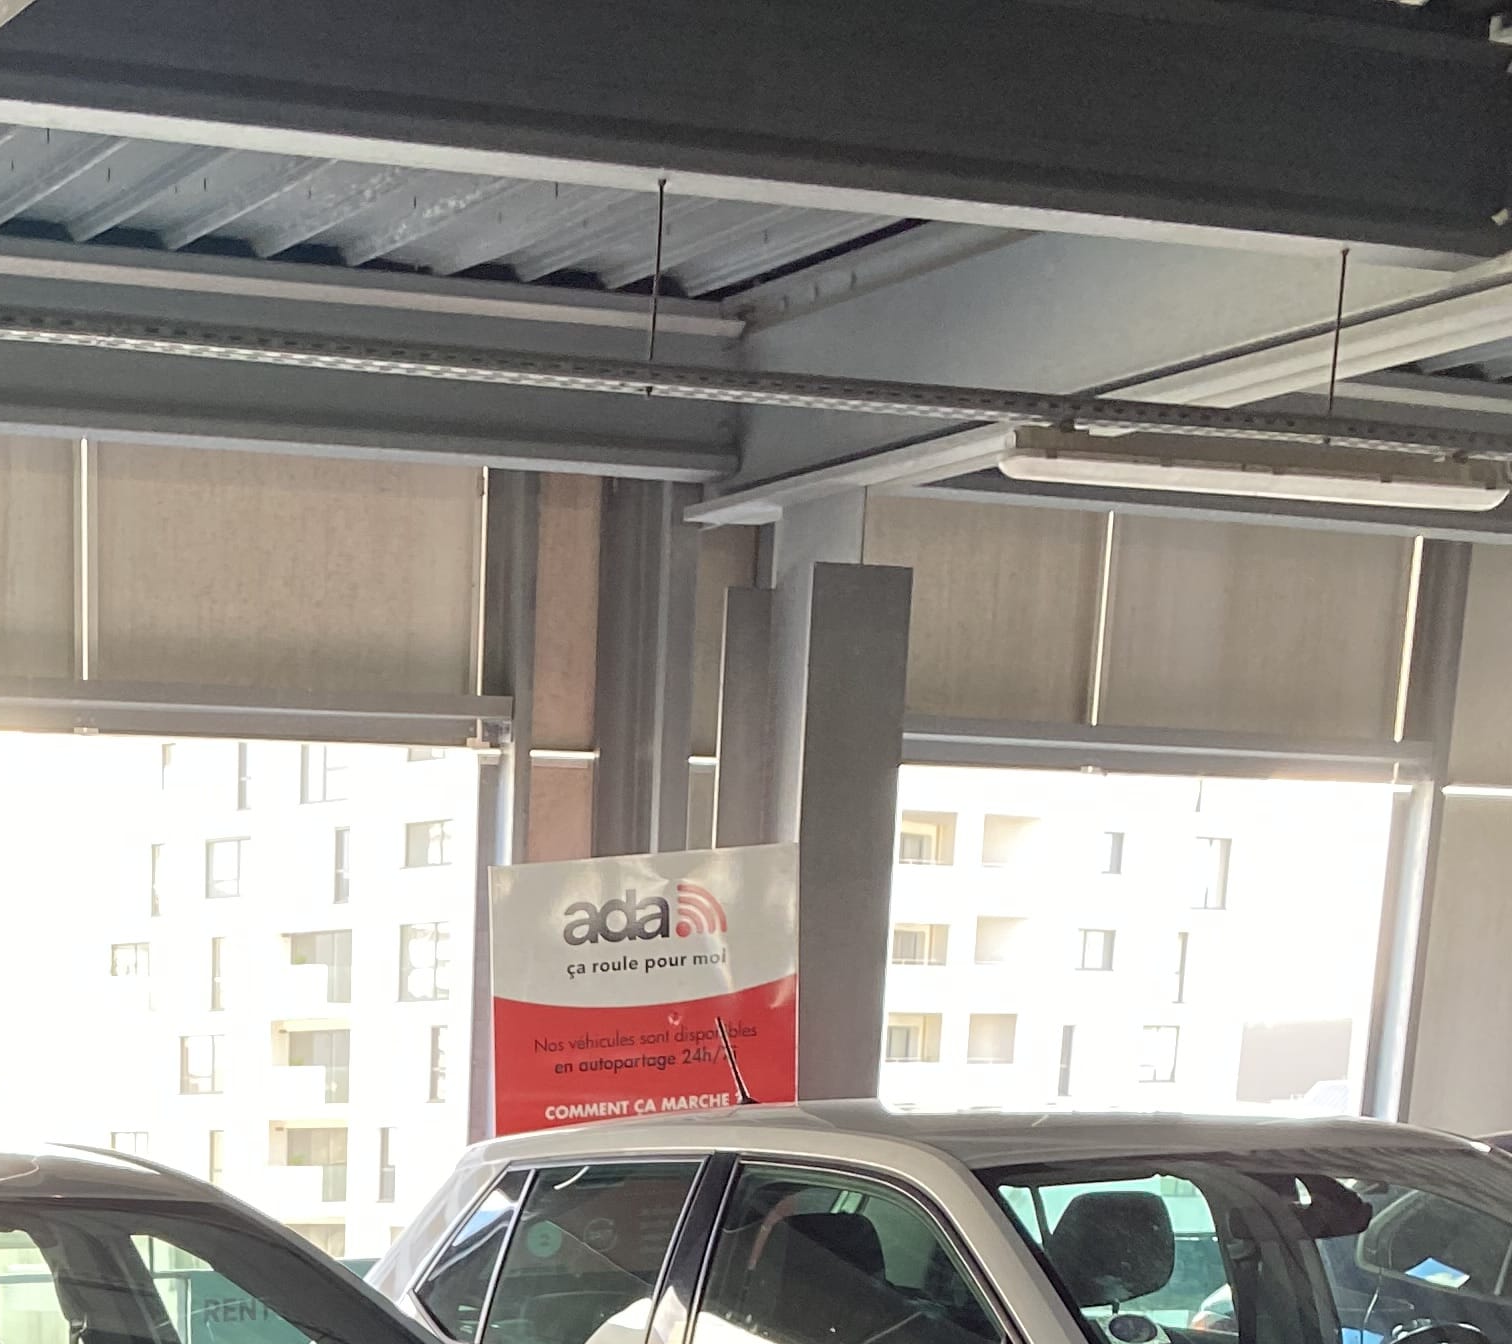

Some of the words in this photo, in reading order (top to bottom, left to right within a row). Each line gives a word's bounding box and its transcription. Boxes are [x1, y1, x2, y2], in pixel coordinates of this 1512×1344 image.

[563, 889, 670, 946] ada
[567, 962, 586, 980] ça
[592, 955, 639, 973] roule
[645, 955, 687, 974] pour
[693, 947, 726, 966] moi
[534, 1037, 565, 1054] Nos
[568, 1029, 635, 1051] véhicules
[640, 1030, 670, 1046] sont
[674, 1020, 757, 1045] dispobles
[555, 1060, 574, 1075] en
[579, 1053, 676, 1076] autopartage
[545, 1099, 630, 1122] COMMENT
[634, 1097, 657, 1116] ÇA
[661, 1092, 730, 1113] MARCHE
